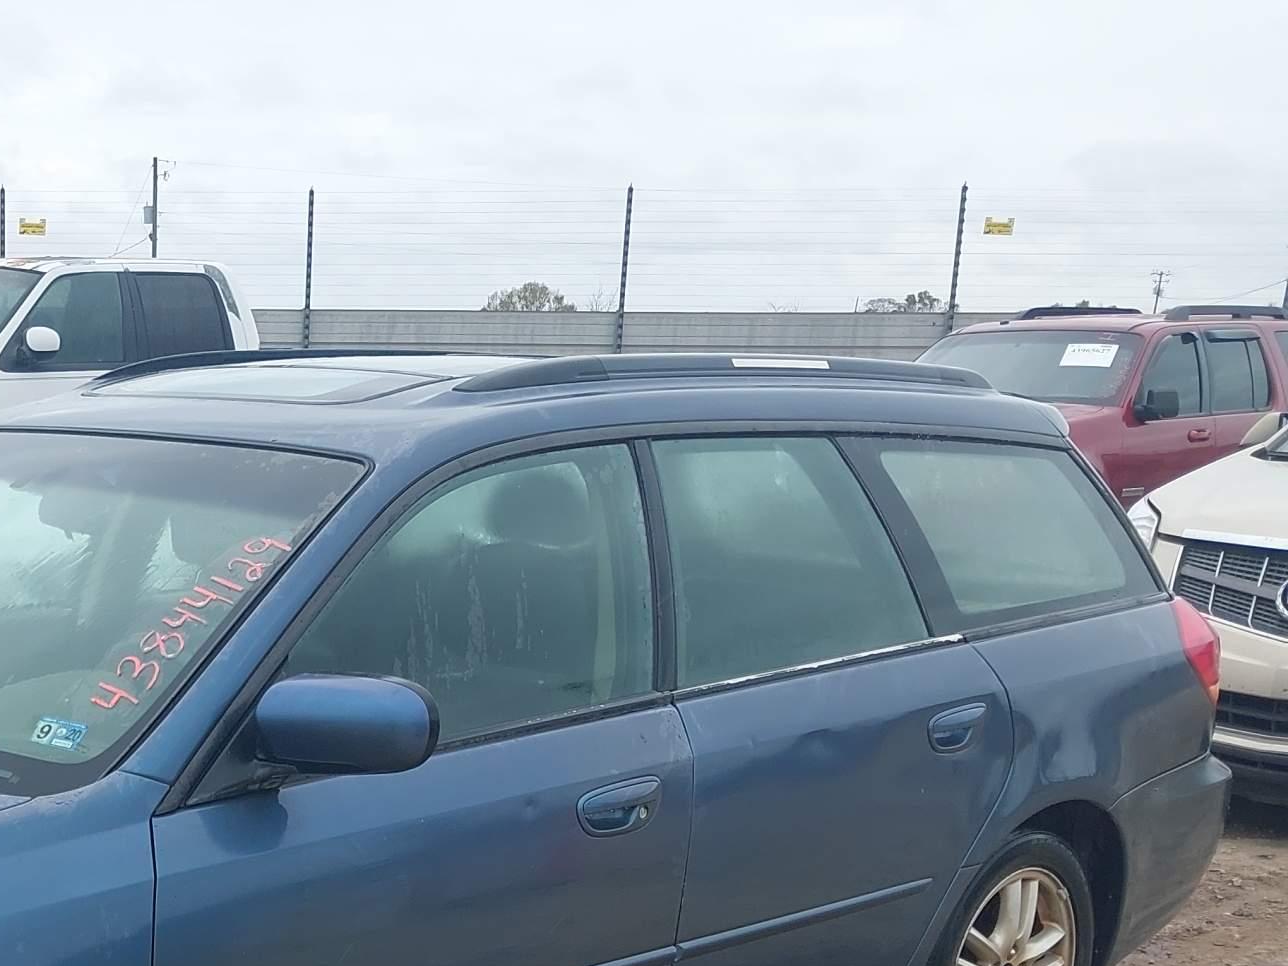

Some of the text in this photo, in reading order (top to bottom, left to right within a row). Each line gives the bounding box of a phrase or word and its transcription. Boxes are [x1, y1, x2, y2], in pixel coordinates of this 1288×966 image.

[90, 536, 292, 709] 43844129
[36, 724, 83, 743] 9 20
